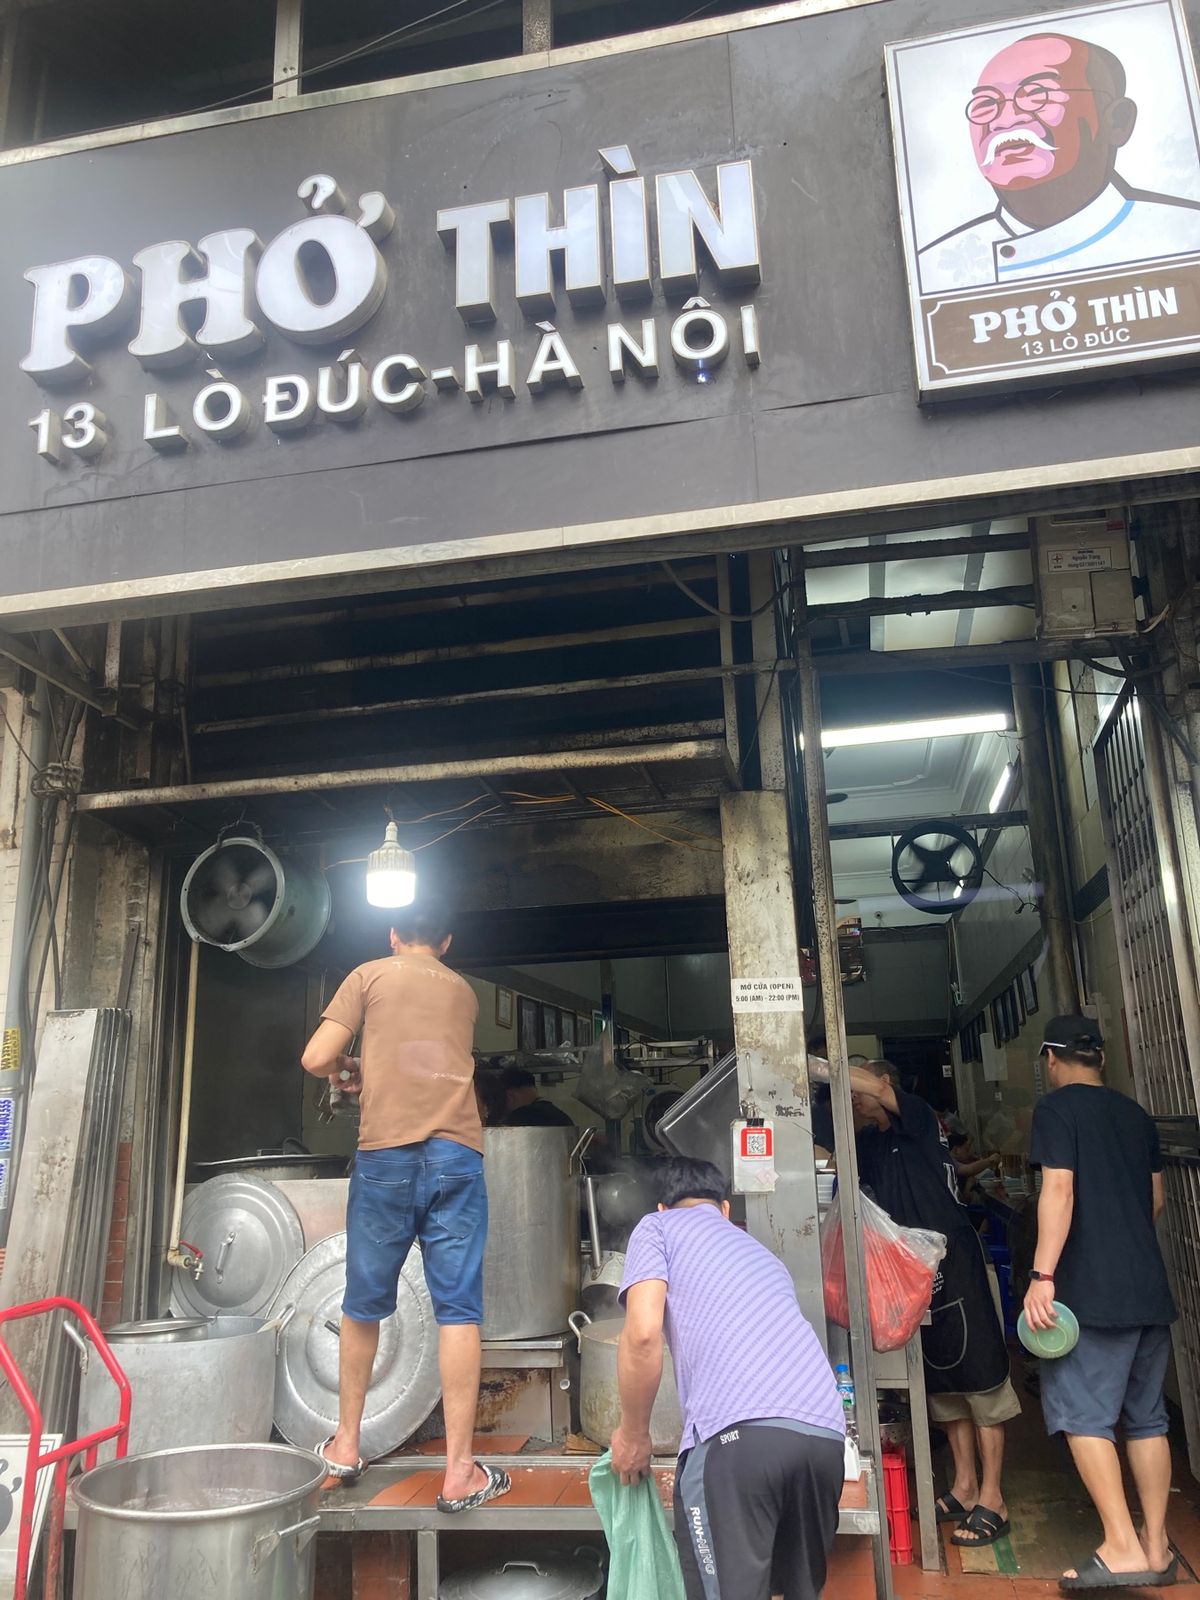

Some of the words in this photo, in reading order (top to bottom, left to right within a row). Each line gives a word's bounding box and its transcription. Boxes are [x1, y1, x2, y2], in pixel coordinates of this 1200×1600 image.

[19, 174, 391, 375] PHỞ
[437, 144, 759, 312] THÌN
[969, 290, 1077, 344] PHỞ
[1088, 286, 1179, 327] THÌN
[1021, 341, 1044, 356] 13
[1050, 332, 1079, 353] LÒ
[28, 402, 102, 460] 13
[144, 368, 247, 446] LÒ
[719, 1429, 740, 1445] SPORT
